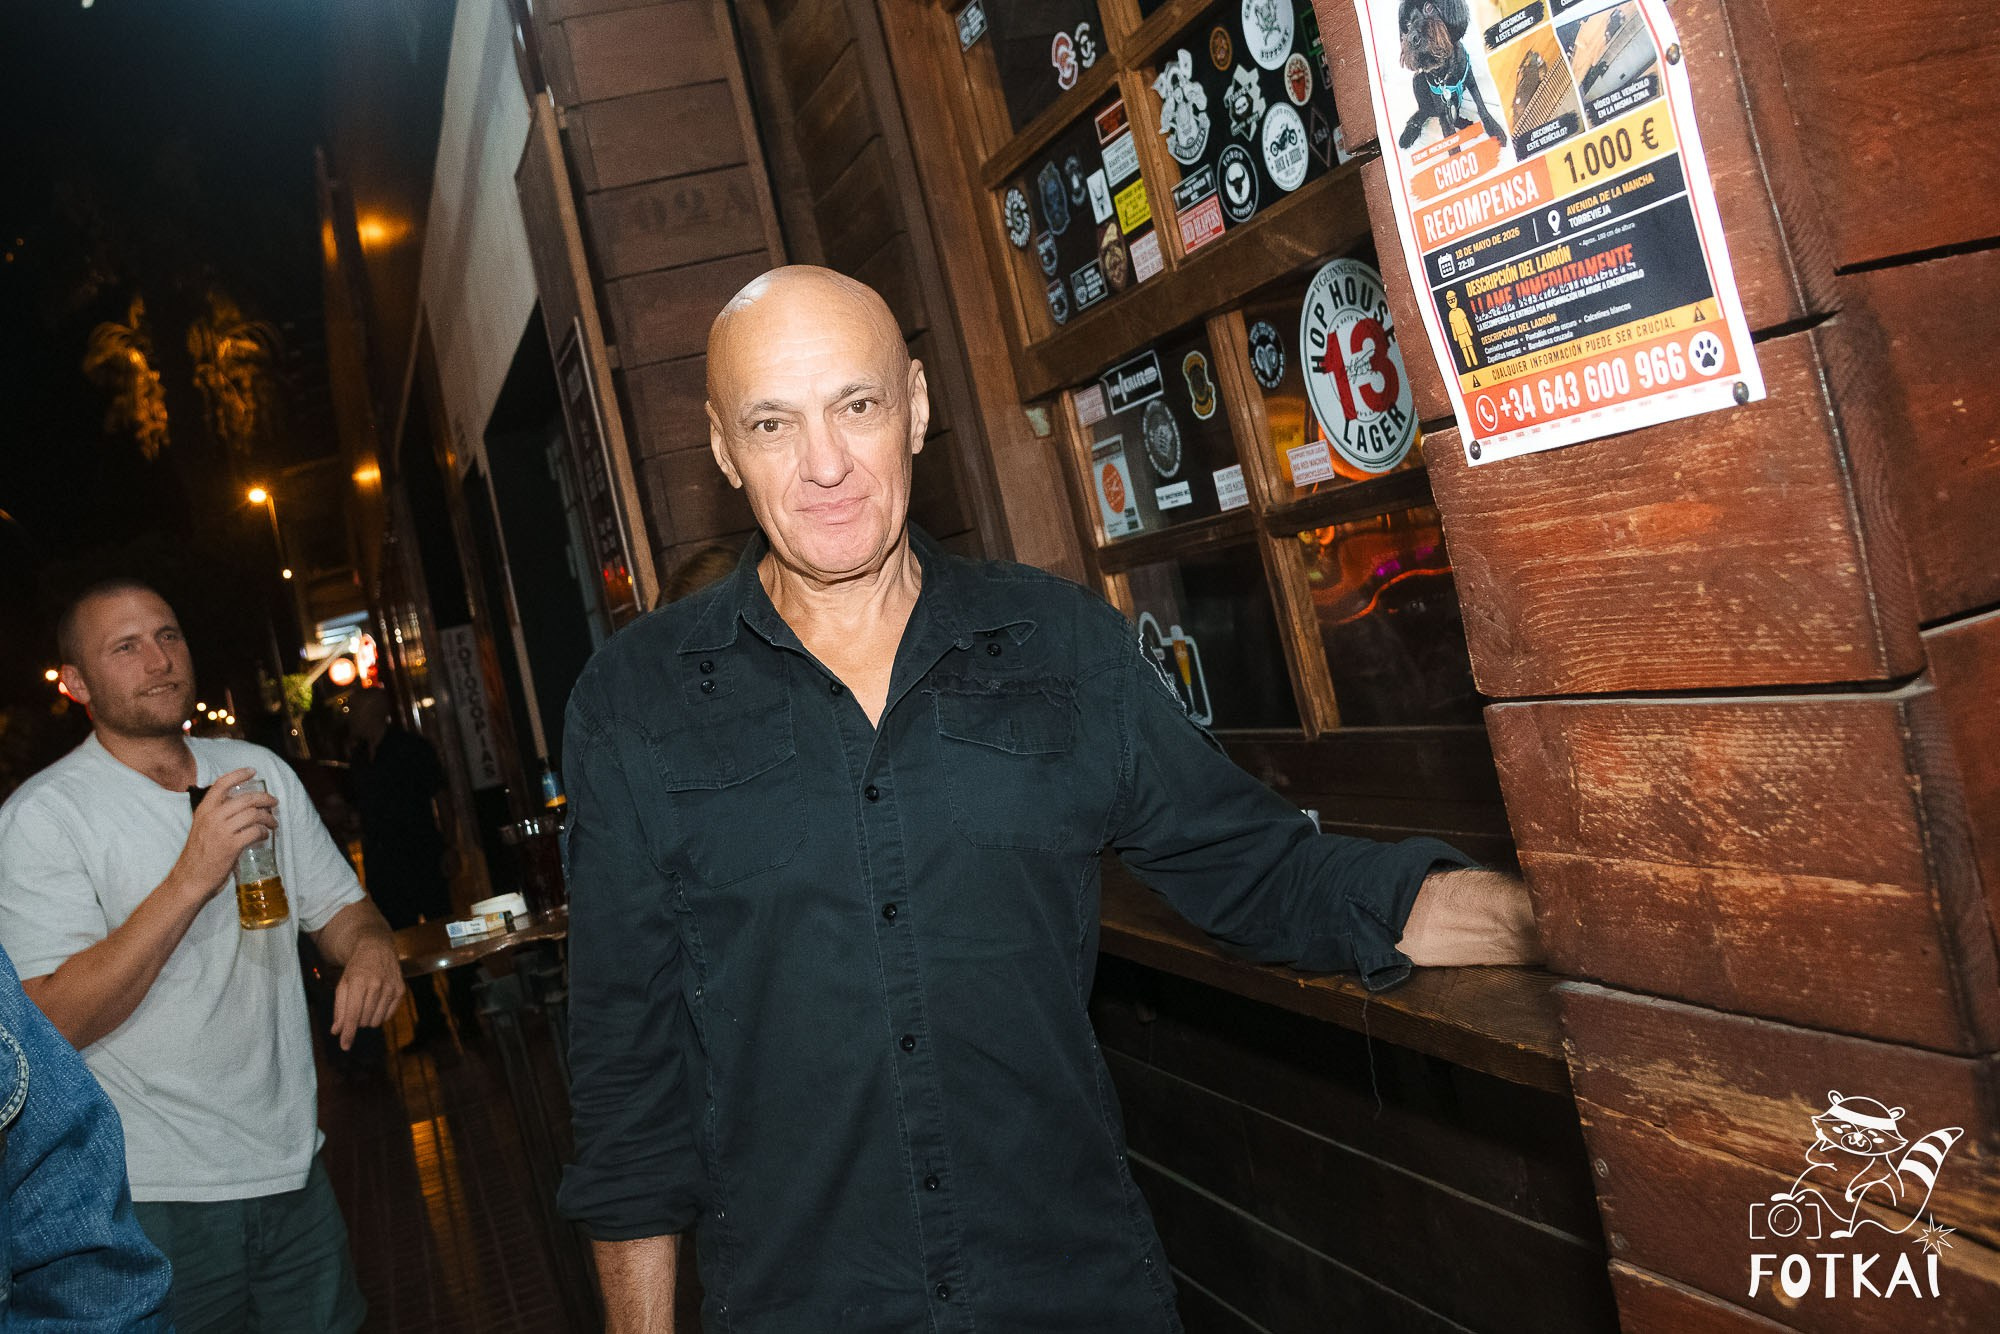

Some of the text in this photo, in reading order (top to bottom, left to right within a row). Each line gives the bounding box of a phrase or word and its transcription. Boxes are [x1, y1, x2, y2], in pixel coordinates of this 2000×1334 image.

[1499, 29, 1511, 41] ESTE
[1597, 89, 1650, 118] EN LA MISMA ZONA
[1610, 91, 1622, 103] DEL
[1620, 78, 1649, 97] VEHÍCULO
[1526, 139, 1540, 151] ESTE
[1564, 117, 1659, 184] 1.000 €
[1433, 151, 1479, 190] CHOCO
[1423, 170, 1539, 244] RECOMPENSA
[1567, 172, 1656, 216] AVENIDA DE LA MANCHA
[1568, 204, 1612, 228] TORREVIEJA
[1455, 226, 1520, 259] 18 DE MAYO DE 2026
[1319, 263, 1358, 288] GUINNESS
[1465, 263, 1519, 298] DESCRIPCIÓN
[1518, 259, 1536, 279] DEL
[1535, 244, 1572, 273] LADRÓN
[1310, 302, 1328, 374] HOP
[1481, 312, 1557, 345] DESCRIPCIÓN DEL LADRÓN
[1491, 316, 1676, 381] CUALQUIER INFORMACIÓN PUEDE SER CRUCIAL
[1319, 318, 1399, 420] 13
[1500, 383, 1536, 422] +34
[1538, 371, 1580, 415] 643
[1583, 357, 1630, 402] 600
[1634, 342, 1686, 388] 966
[1344, 404, 1407, 454] LAGER
[456, 631, 496, 778] FOTOCOPIAS
